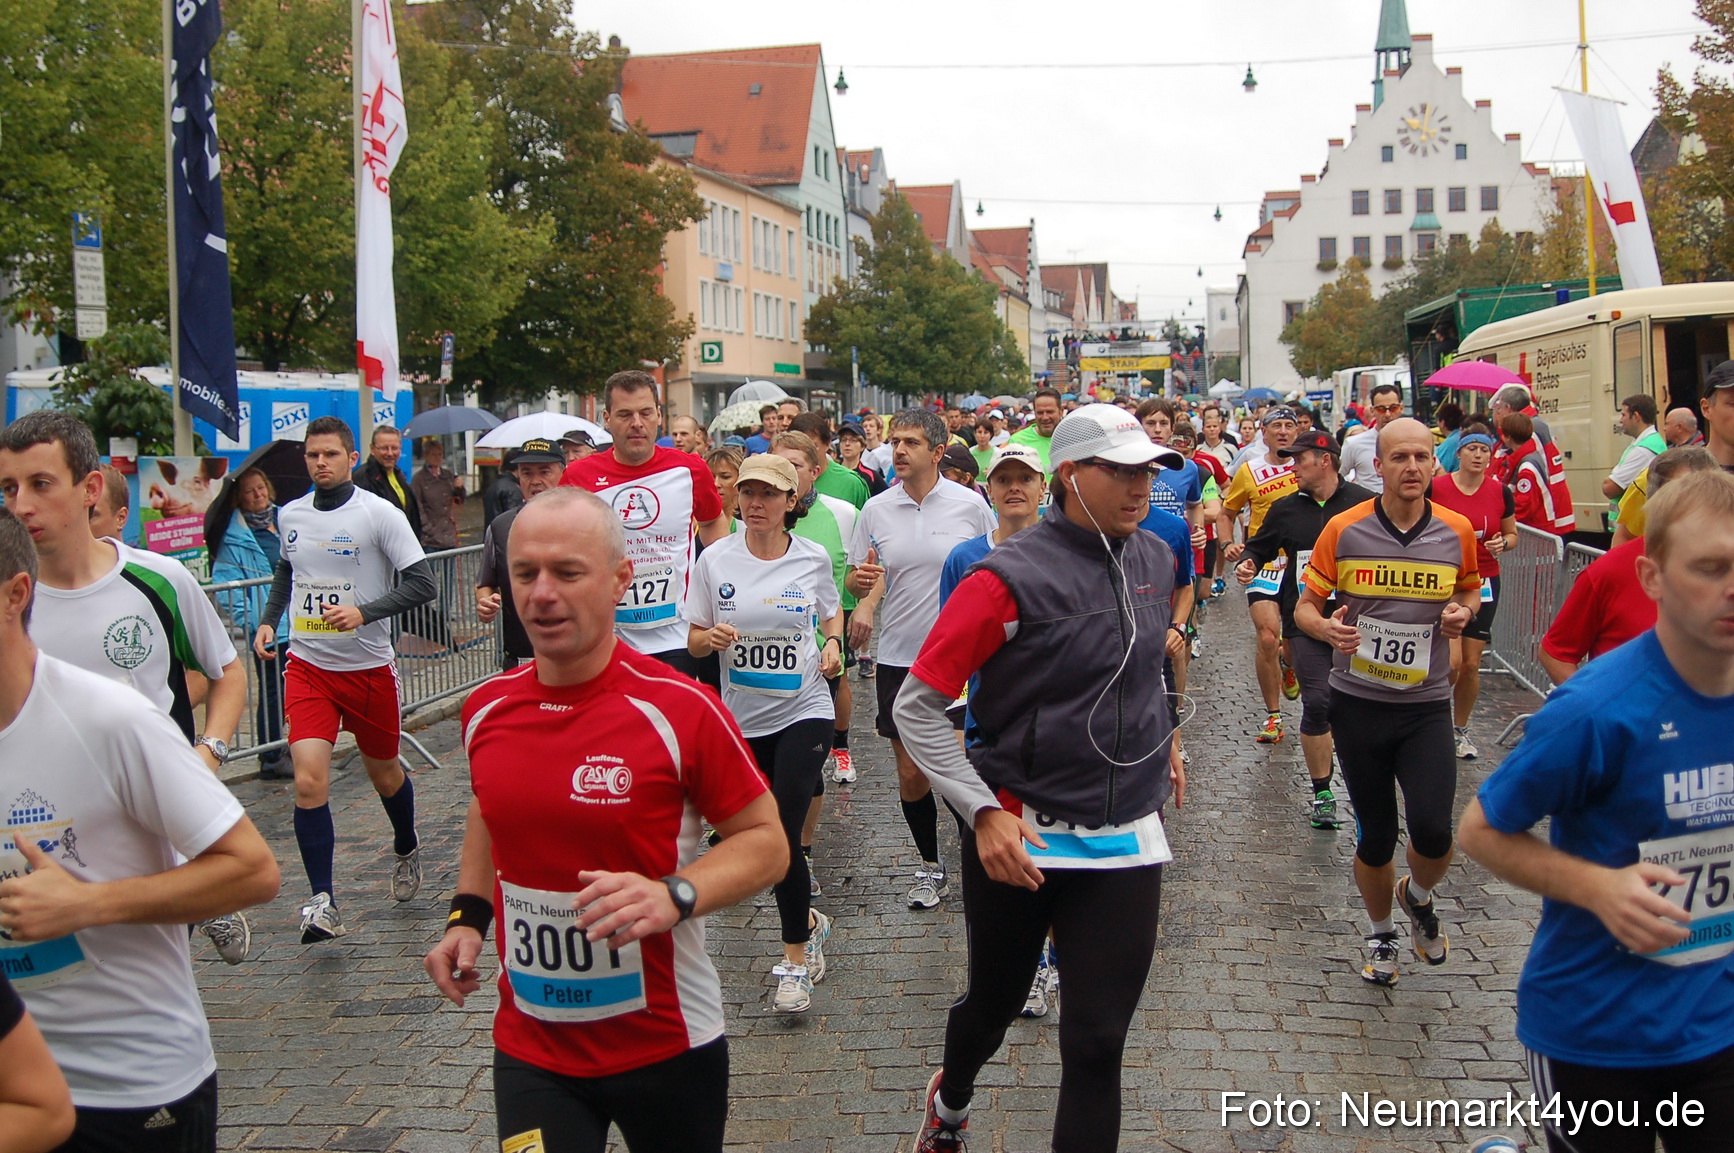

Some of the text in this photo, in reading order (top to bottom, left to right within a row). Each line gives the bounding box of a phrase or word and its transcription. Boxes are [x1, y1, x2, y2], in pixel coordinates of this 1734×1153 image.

[703, 343, 720, 360] D
[1537, 342, 1586, 369] Bayerisches
[1536, 372, 1559, 391] Rotes
[1537, 396, 1559, 414] Kreuz
[272, 408, 308, 430] DIXI
[373, 408, 394, 423] IXI
[1258, 480, 1286, 496] MAX
[637, 537, 652, 545] MIT
[655, 535, 677, 544] HERZ
[632, 571, 662, 580] eumarkt
[633, 609, 655, 621] Willi
[1358, 621, 1420, 638] PARTL Neumarkt
[733, 644, 797, 670] 3096
[1371, 636, 1416, 665] 136
[1367, 664, 1408, 681] Stephan
[539, 702, 568, 712] CRAFT
[586, 755, 624, 764] Laufteam
[570, 793, 600, 804] Kraftsport
[1689, 843, 1734, 859] Neuma
[504, 895, 538, 915] PARTL
[543, 983, 593, 1003] Peter
[144, 1117, 176, 1128] adidas
